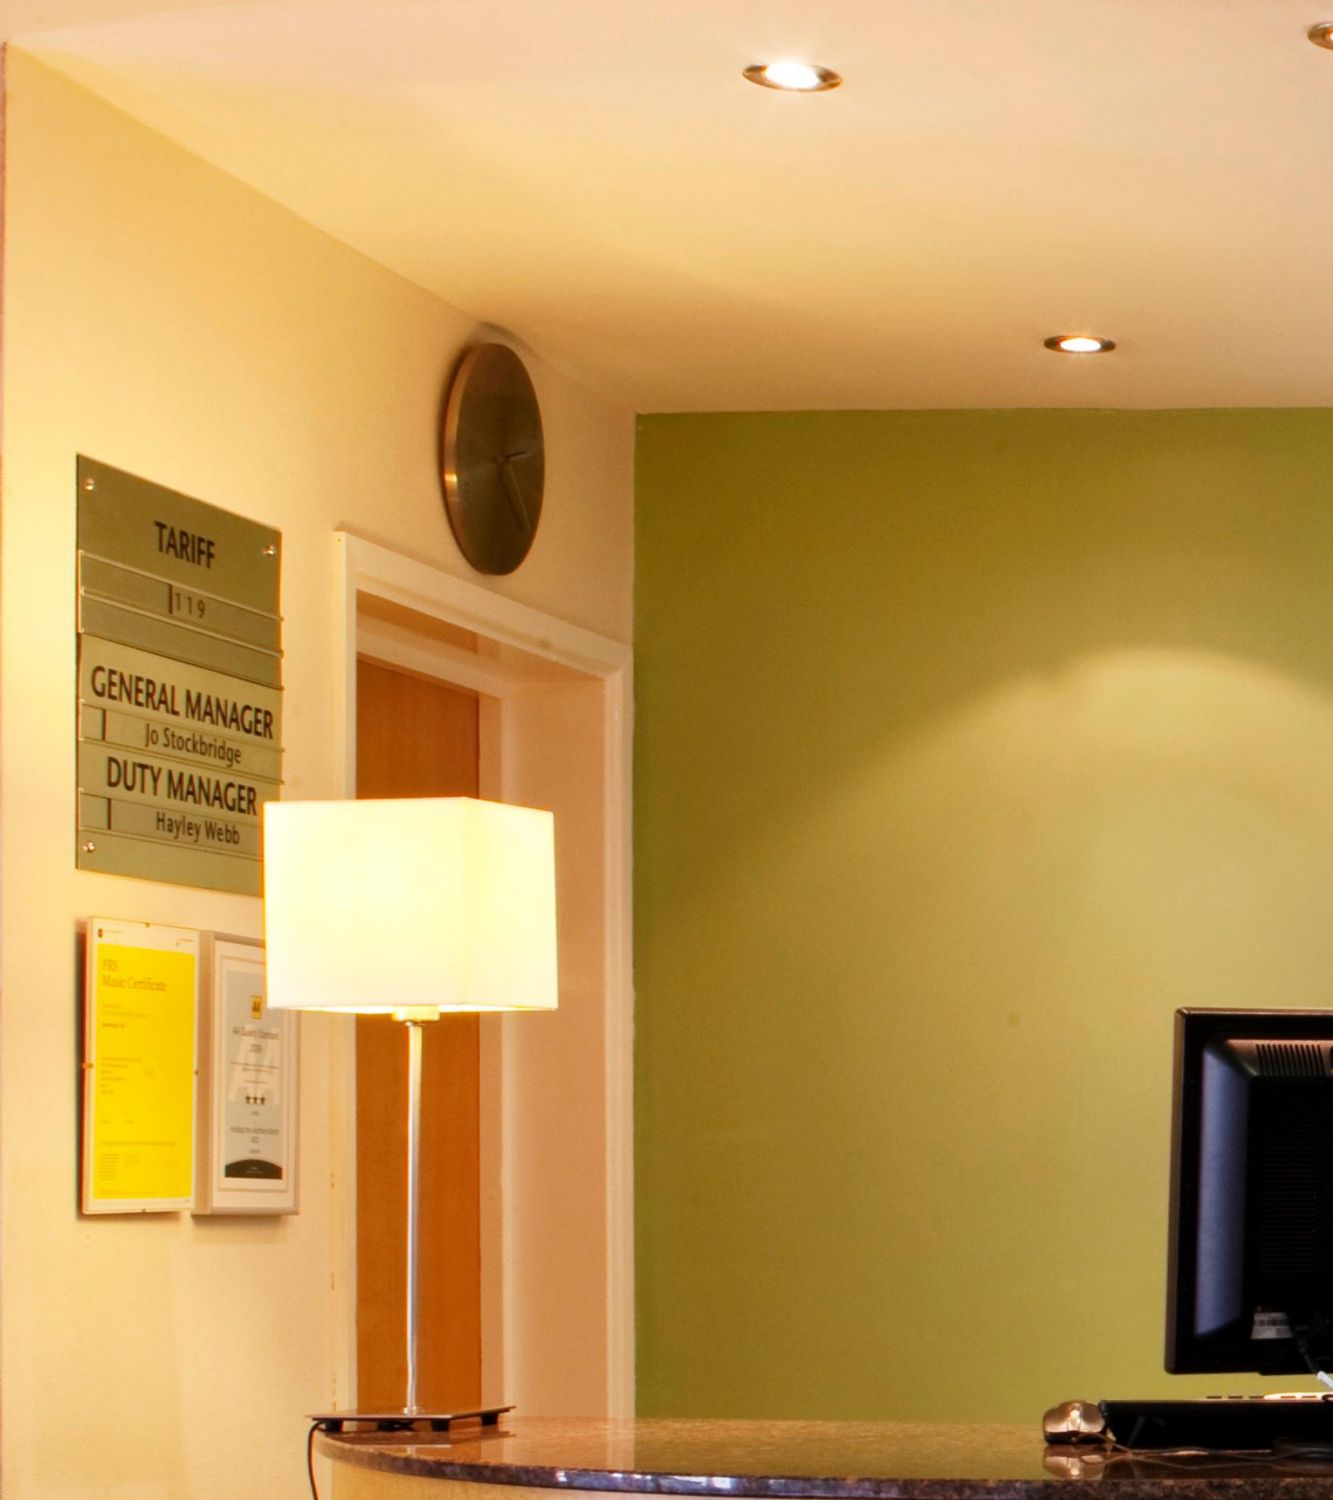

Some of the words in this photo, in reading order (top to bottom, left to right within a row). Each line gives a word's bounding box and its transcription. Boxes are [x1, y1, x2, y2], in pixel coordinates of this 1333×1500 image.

[155, 520, 216, 569] TARIFF
[91, 665, 180, 717] GENERAL
[184, 691, 275, 740] MANAGER
[145, 723, 159, 748] Jo
[163, 727, 242, 767] Stockbridge
[106, 756, 162, 797] DUTY
[167, 770, 258, 816] MANAGER
[156, 811, 201, 844] Hayley
[205, 817, 241, 845] Webb
